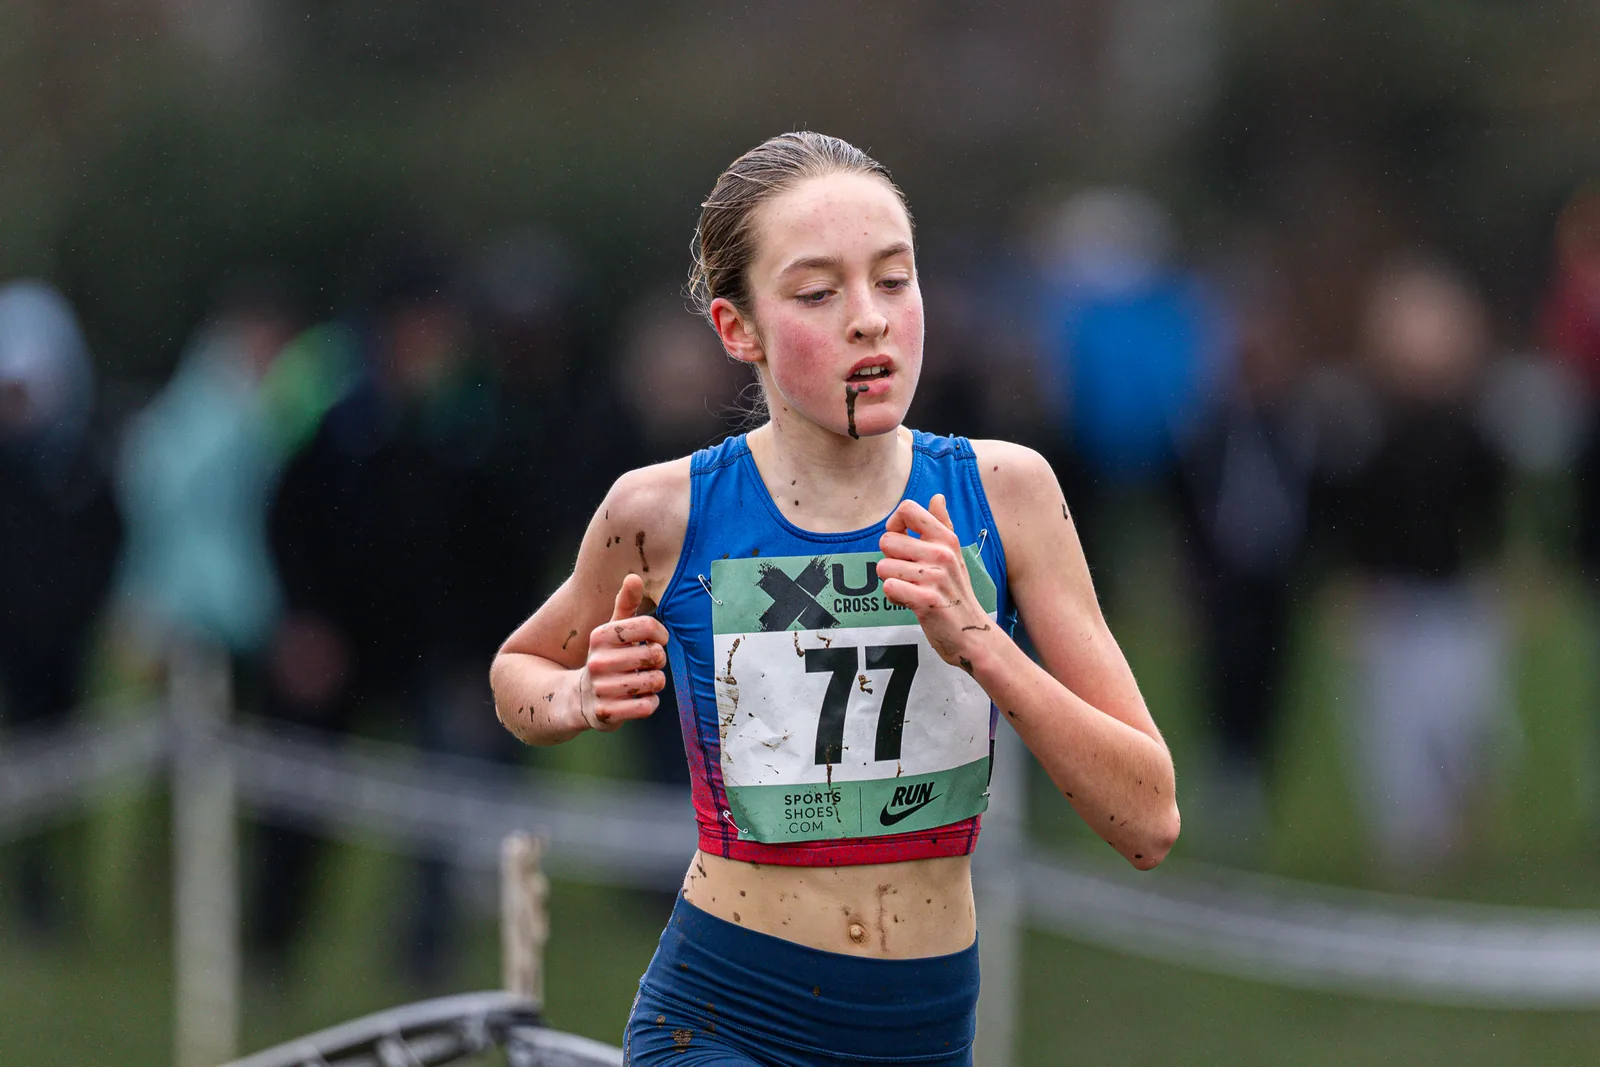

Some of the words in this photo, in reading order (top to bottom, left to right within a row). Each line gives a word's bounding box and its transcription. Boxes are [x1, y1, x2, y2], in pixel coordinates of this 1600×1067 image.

[832, 562, 884, 597] U
[834, 597, 879, 613] CROSS
[804, 643, 919, 766] 77
[784, 792, 841, 806] SPORTS
[890, 782, 935, 807] RUN
[784, 806, 833, 820] SHOES
[785, 821, 823, 834] .COM
